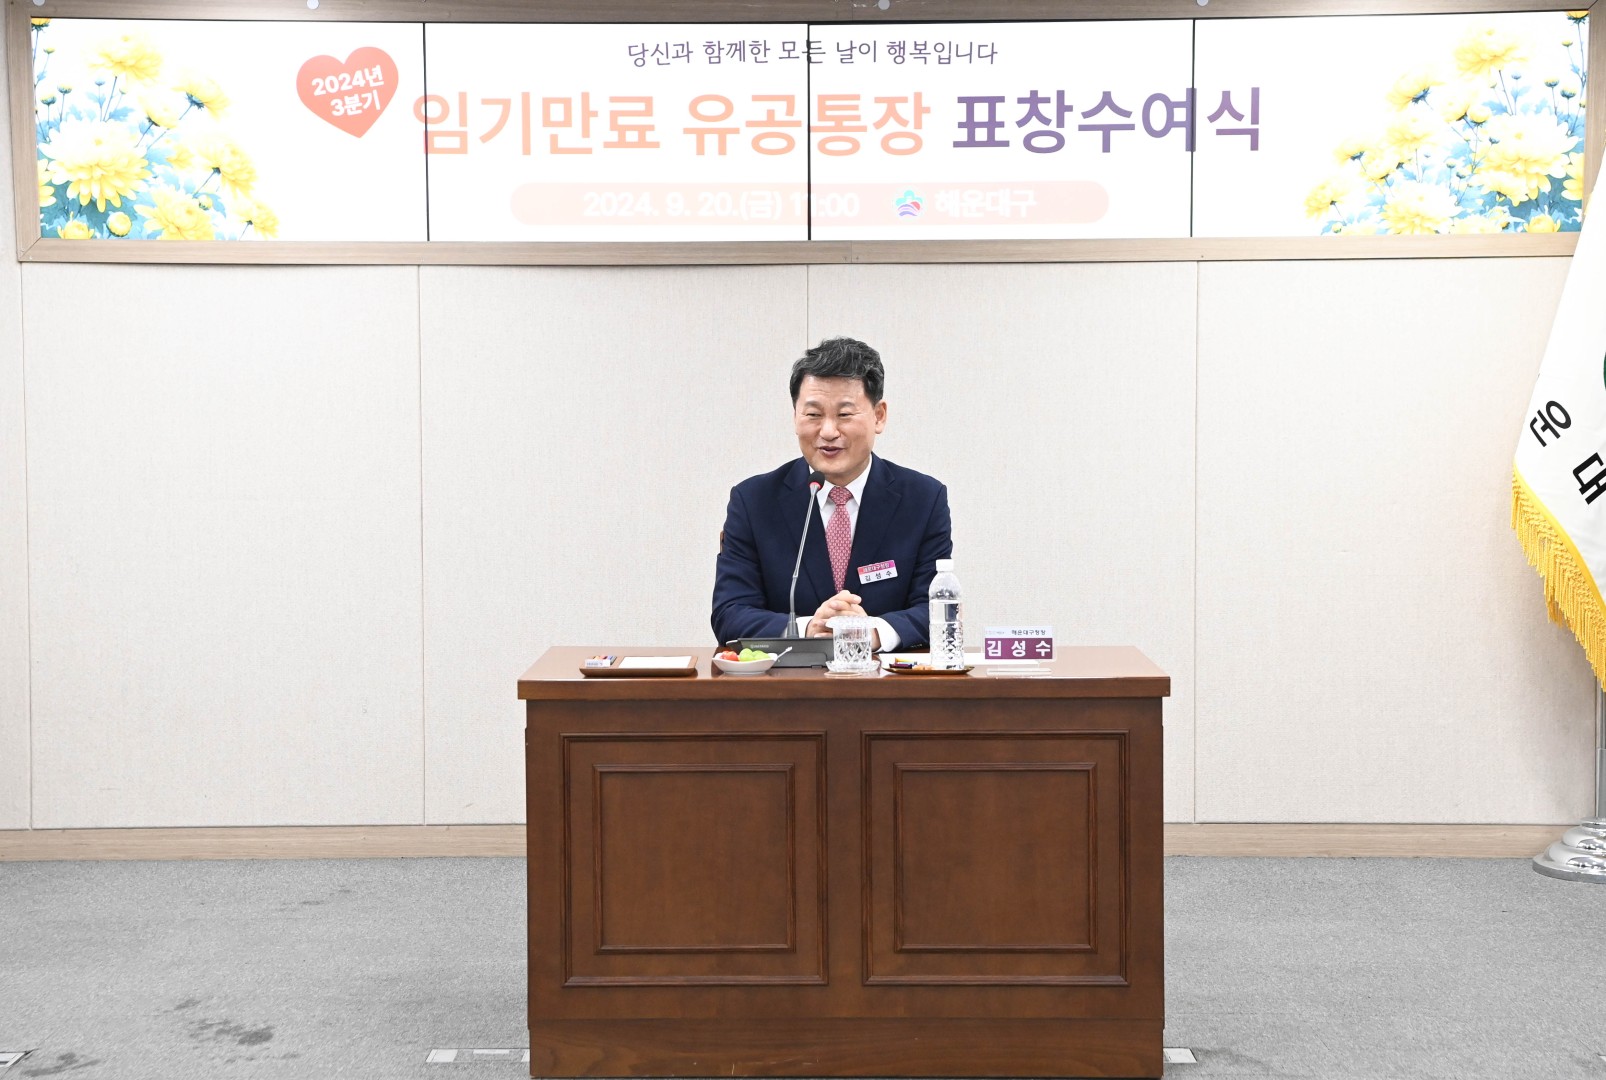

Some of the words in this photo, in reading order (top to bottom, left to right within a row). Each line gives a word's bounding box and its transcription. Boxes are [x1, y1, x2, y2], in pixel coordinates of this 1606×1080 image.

[627, 42, 694, 67] 당신과
[702, 40, 771, 65] 함께한
[778, 39, 826, 64] 모든
[835, 40, 878, 63] 날이
[886, 40, 998, 65] 행복입니다
[311, 64, 385, 97] 2024년
[330, 89, 381, 117] 3분기
[412, 91, 661, 156] 임기만료
[682, 91, 931, 156] 유공통장
[952, 86, 1261, 154] 표창수여식
[583, 190, 660, 218] 2024.
[934, 189, 1038, 218] 해운대구
